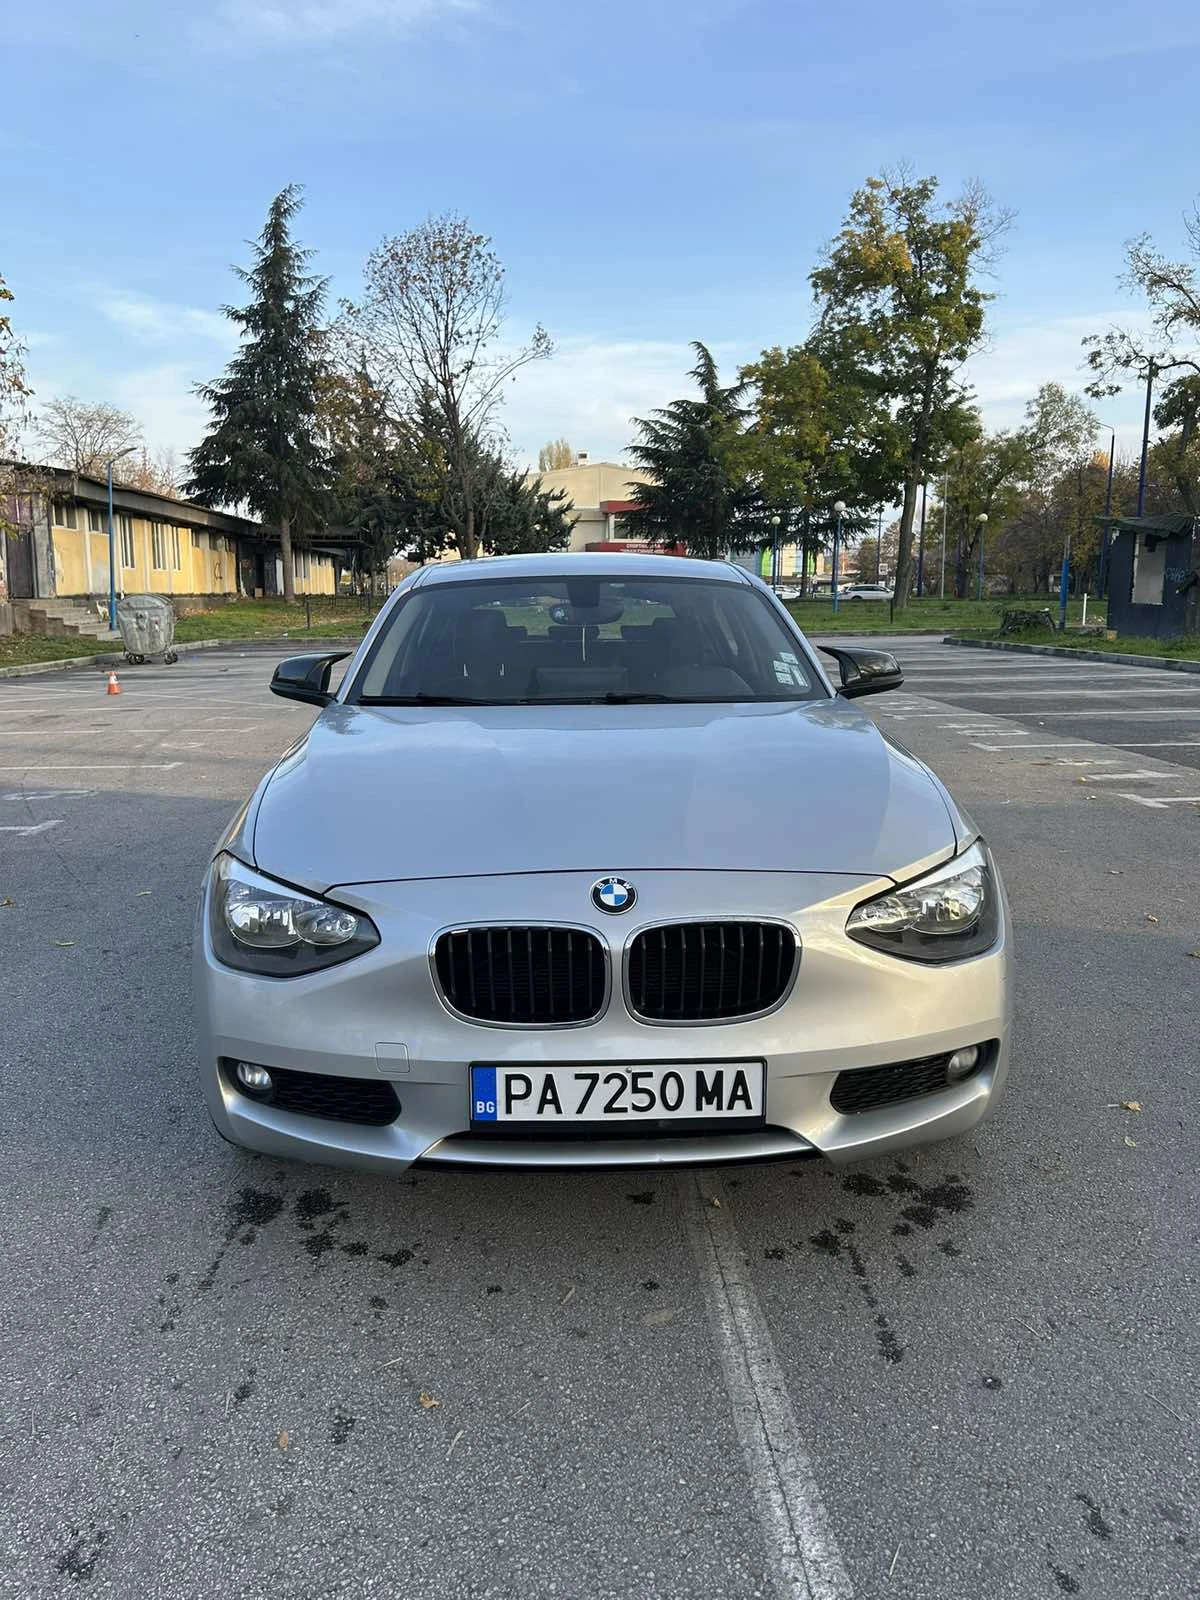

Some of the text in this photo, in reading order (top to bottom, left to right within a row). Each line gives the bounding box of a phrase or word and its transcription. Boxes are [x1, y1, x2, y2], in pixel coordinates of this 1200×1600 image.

[596, 878, 633, 889] BMW
[504, 1069, 753, 1116] PA 7250 MA
[476, 1101, 496, 1114] BG
